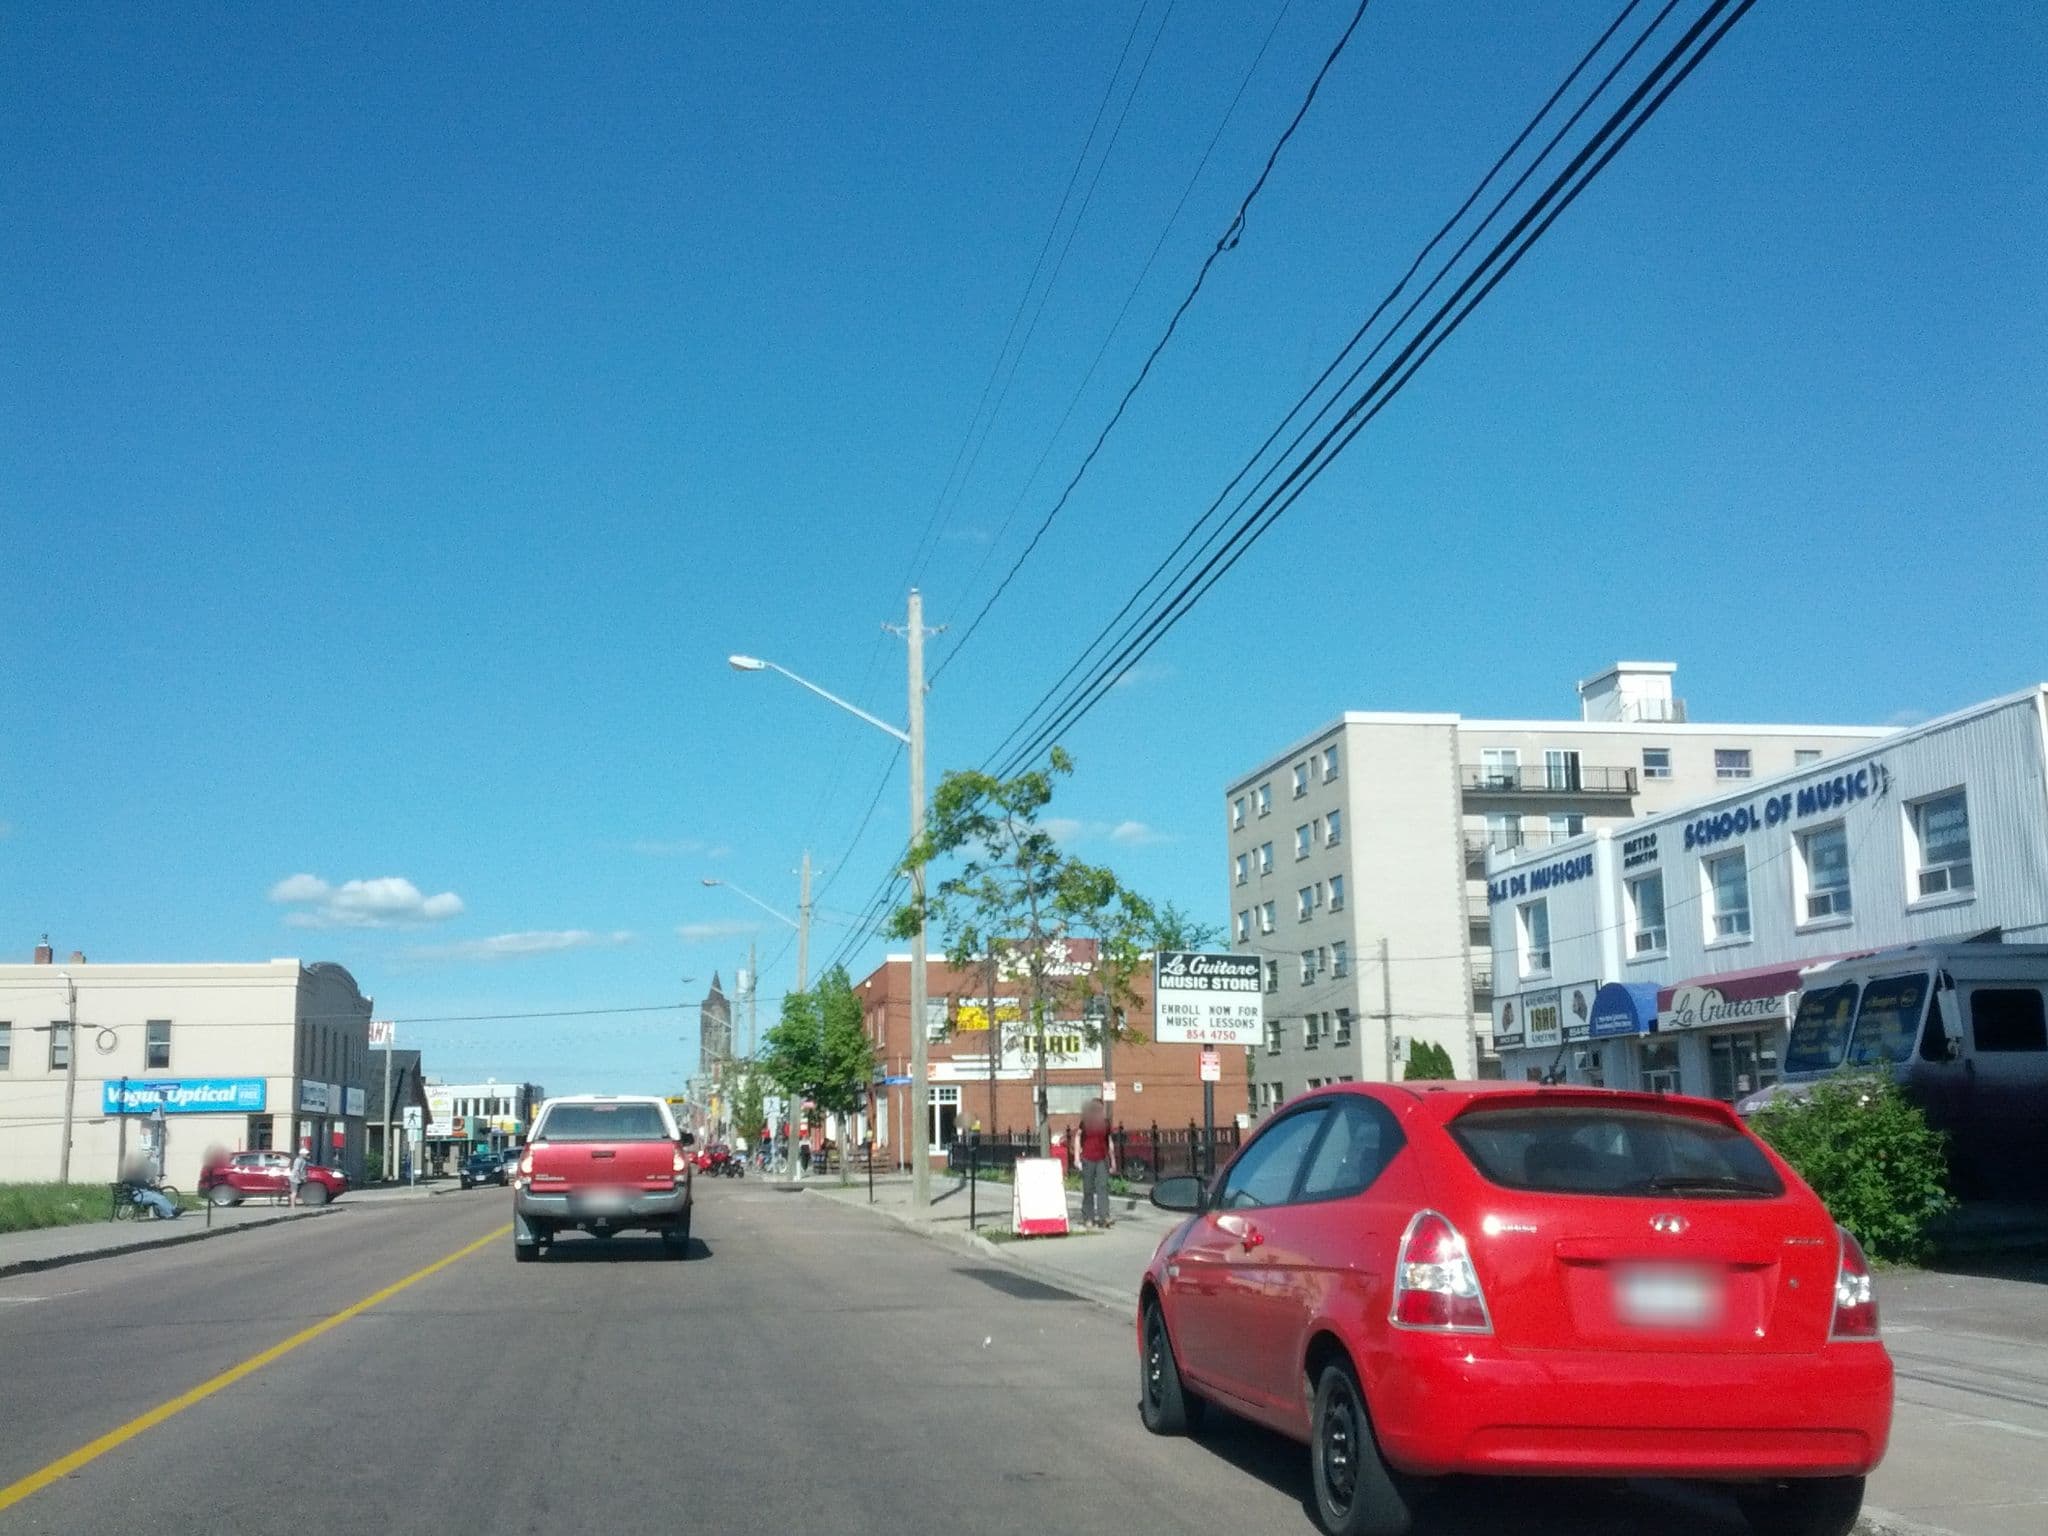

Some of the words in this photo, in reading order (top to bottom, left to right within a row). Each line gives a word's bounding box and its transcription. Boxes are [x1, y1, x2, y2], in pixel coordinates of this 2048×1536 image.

[1684, 805, 1760, 850] SCHOOL
[1765, 793, 1792, 829] OF
[1797, 769, 1868, 817] MUSIC
[1623, 832, 1657, 855] METRO
[1510, 873, 1527, 898] DE
[1530, 853, 1593, 892] MUSIQUE
[1161, 955, 1187, 976] La
[1189, 955, 1259, 975] Guitare
[1161, 976, 1209, 990] MUSIC
[1212, 977, 1259, 991] STORE
[1161, 1004, 1200, 1015] ENROLL
[1209, 1006, 1231, 1016] NOW
[1238, 1006, 1258, 1016] FOR
[1669, 991, 1693, 1027] La
[1700, 987, 1781, 1023] Guitare
[1166, 1016, 1199, 1027] MUSIC
[1210, 1018, 1255, 1029] LESSONS
[1186, 1029, 1205, 1040] 854
[1211, 1030, 1236, 1040] 4750
